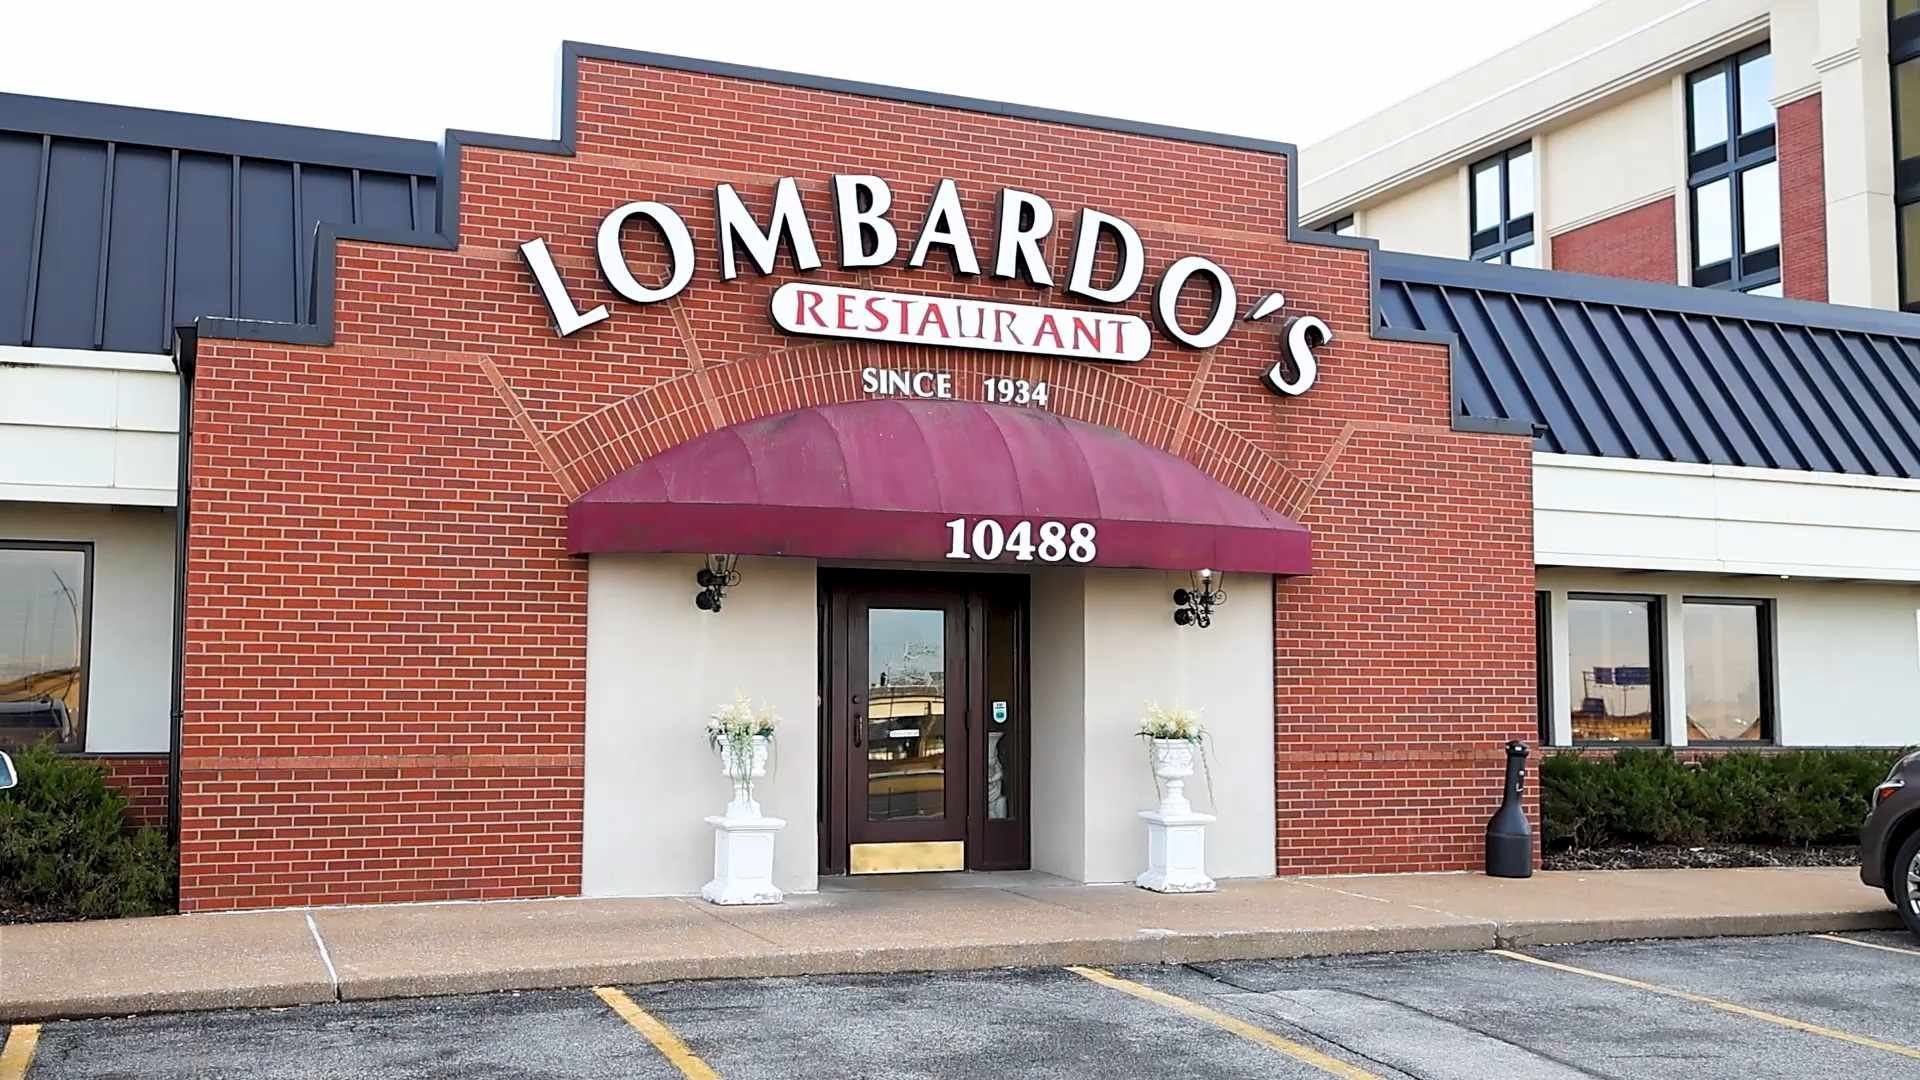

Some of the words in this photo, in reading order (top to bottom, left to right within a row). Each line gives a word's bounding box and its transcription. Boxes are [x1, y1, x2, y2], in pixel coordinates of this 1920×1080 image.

[520, 174, 1334, 397] LOMBARDO'S
[794, 290, 1132, 354] RESTAURANT
[862, 366, 952, 400] SINCE
[985, 378, 1049, 406] 1934
[945, 518, 1098, 564] 10488
